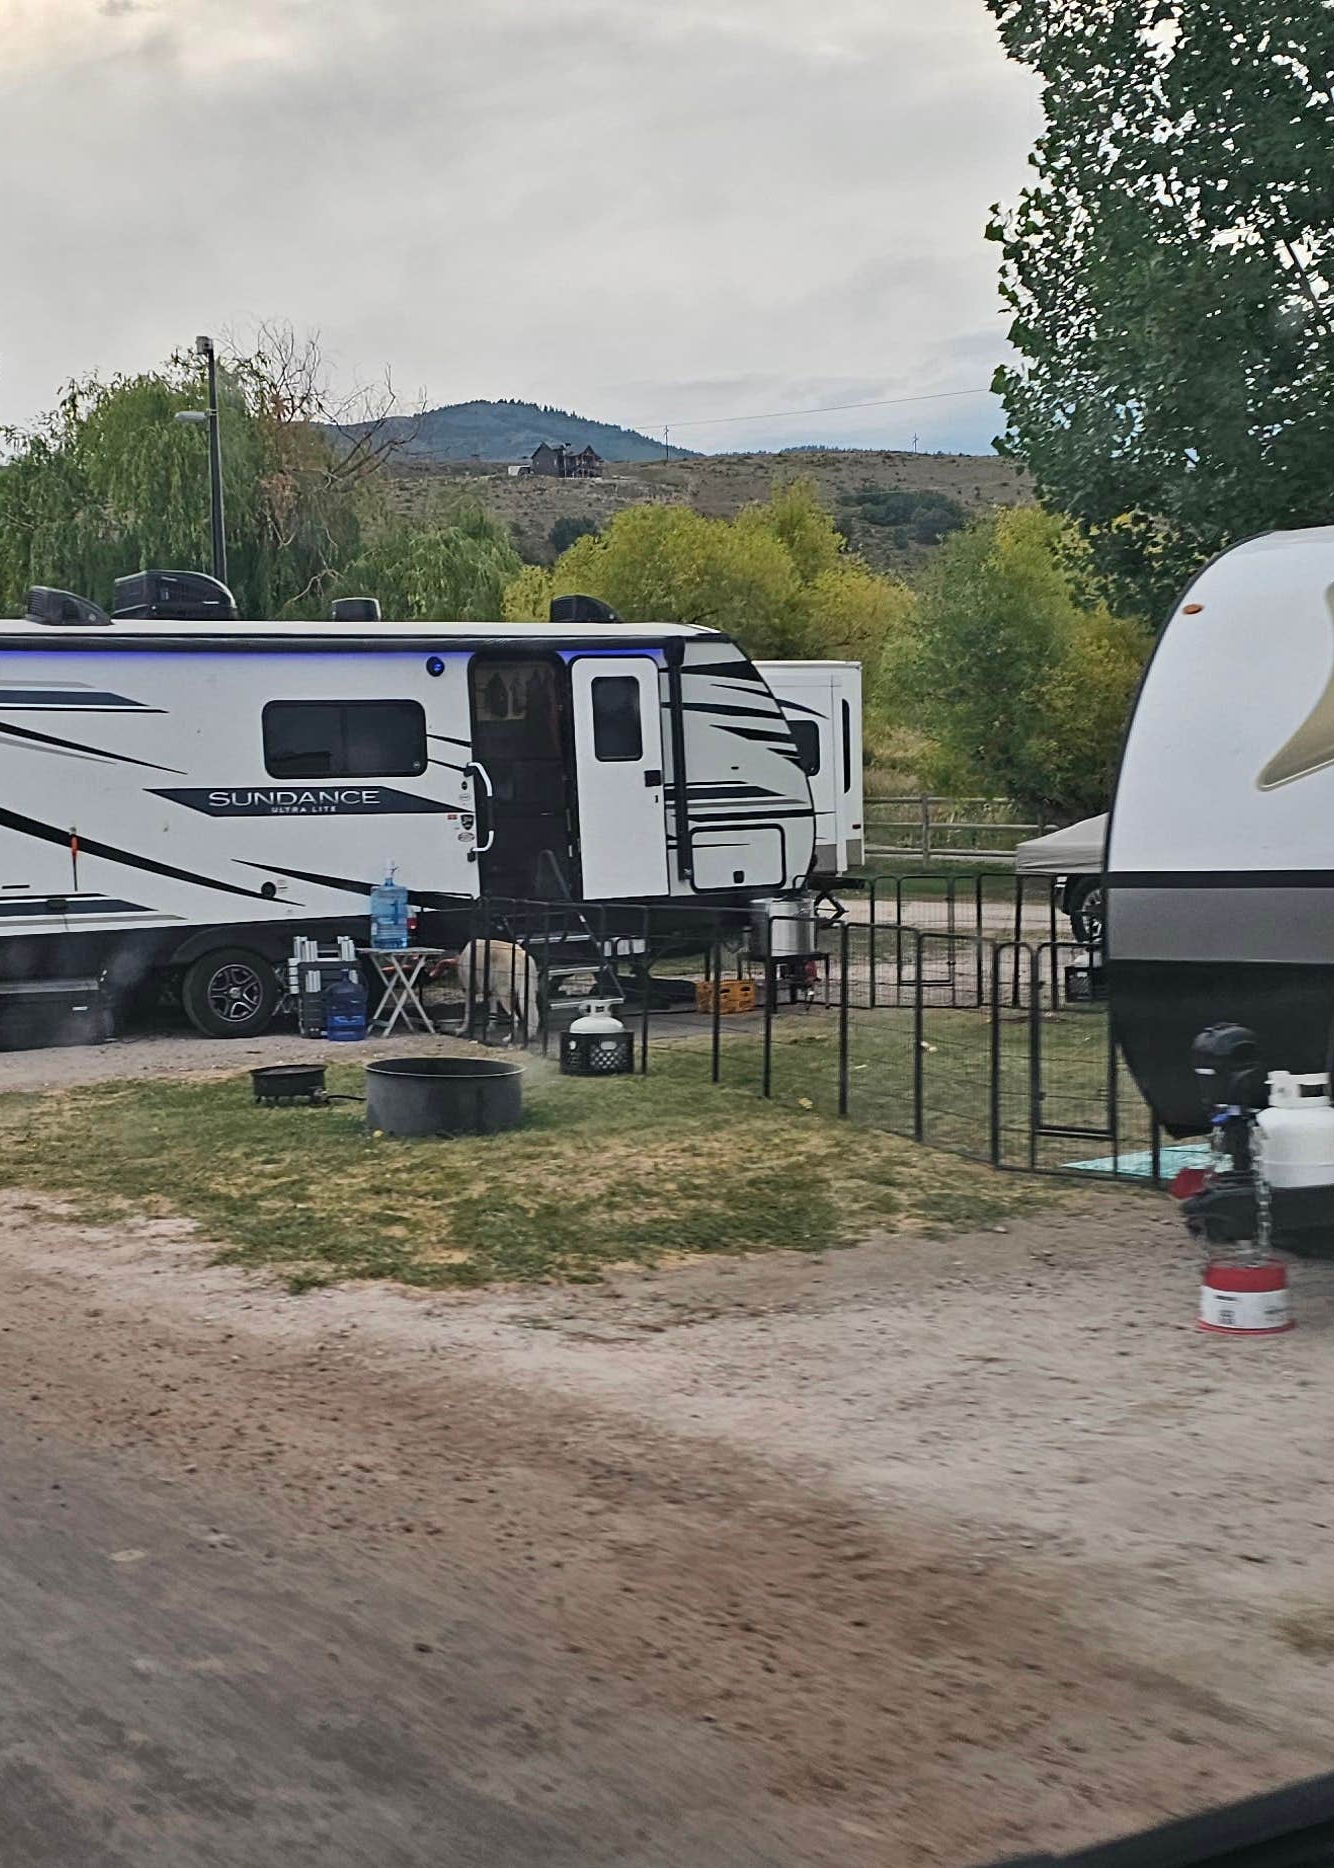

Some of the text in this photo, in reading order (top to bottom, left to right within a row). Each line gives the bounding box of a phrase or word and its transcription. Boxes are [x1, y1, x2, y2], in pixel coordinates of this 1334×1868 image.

[209, 790, 380, 806] SUNDANCE
[271, 805, 336, 814] ULTRA LITE
